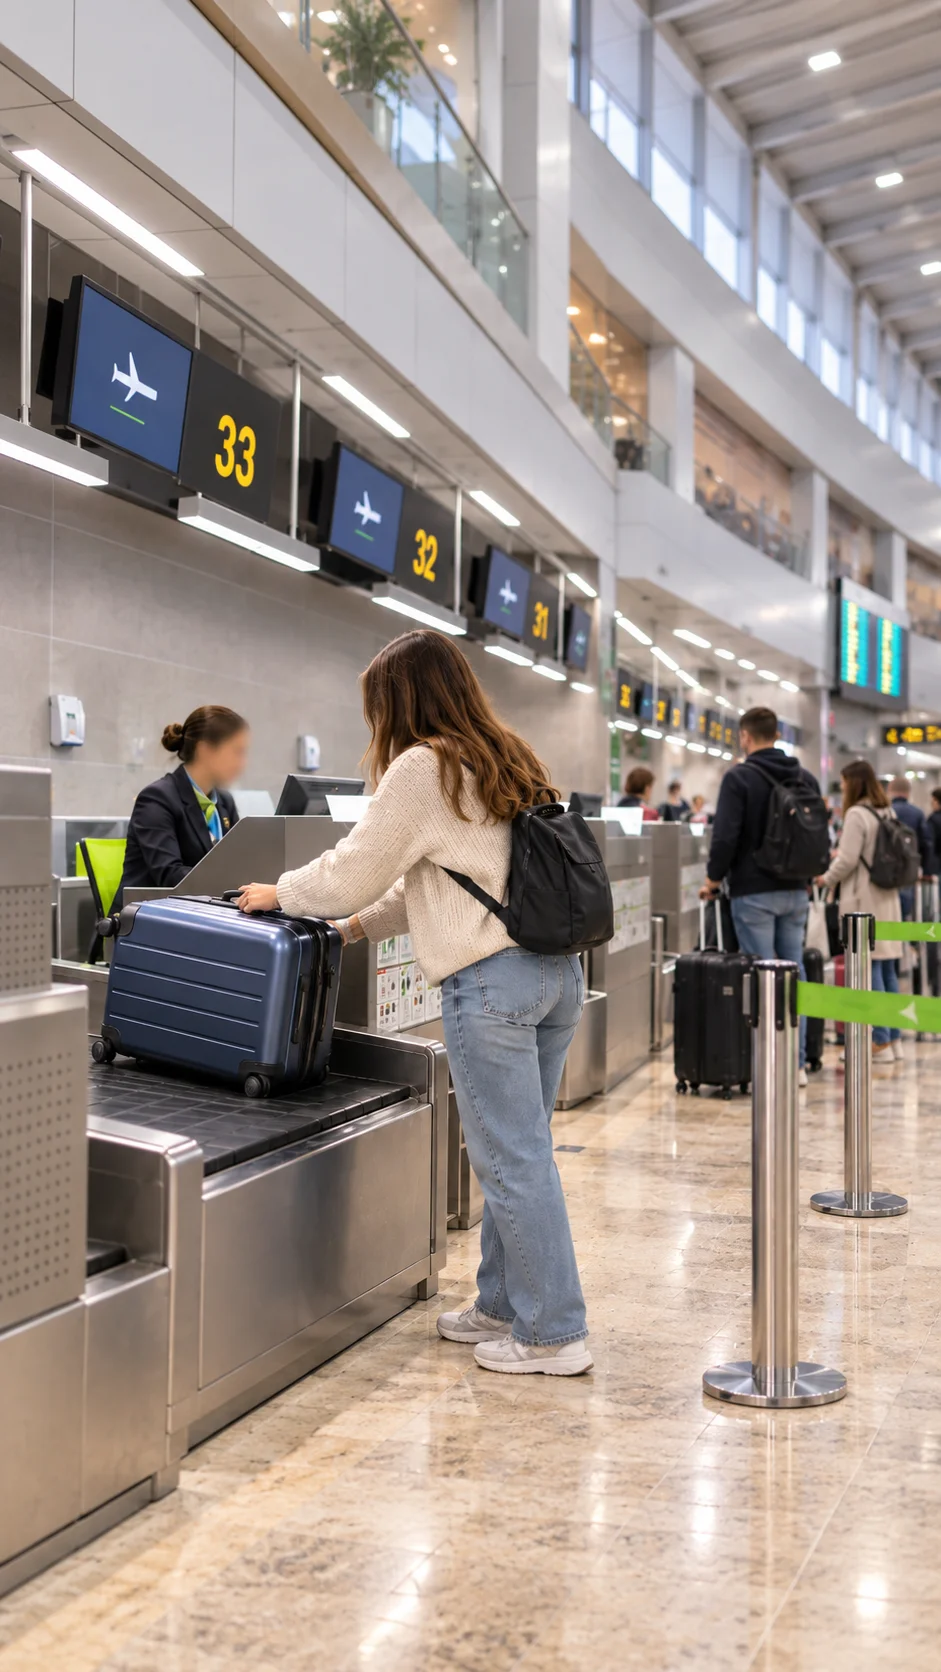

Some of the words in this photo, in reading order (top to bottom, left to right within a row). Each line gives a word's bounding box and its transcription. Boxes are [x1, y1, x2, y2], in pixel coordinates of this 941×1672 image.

[214, 414, 257, 488] 33
[412, 528, 439, 582] 32
[532, 601, 549, 640] 31
